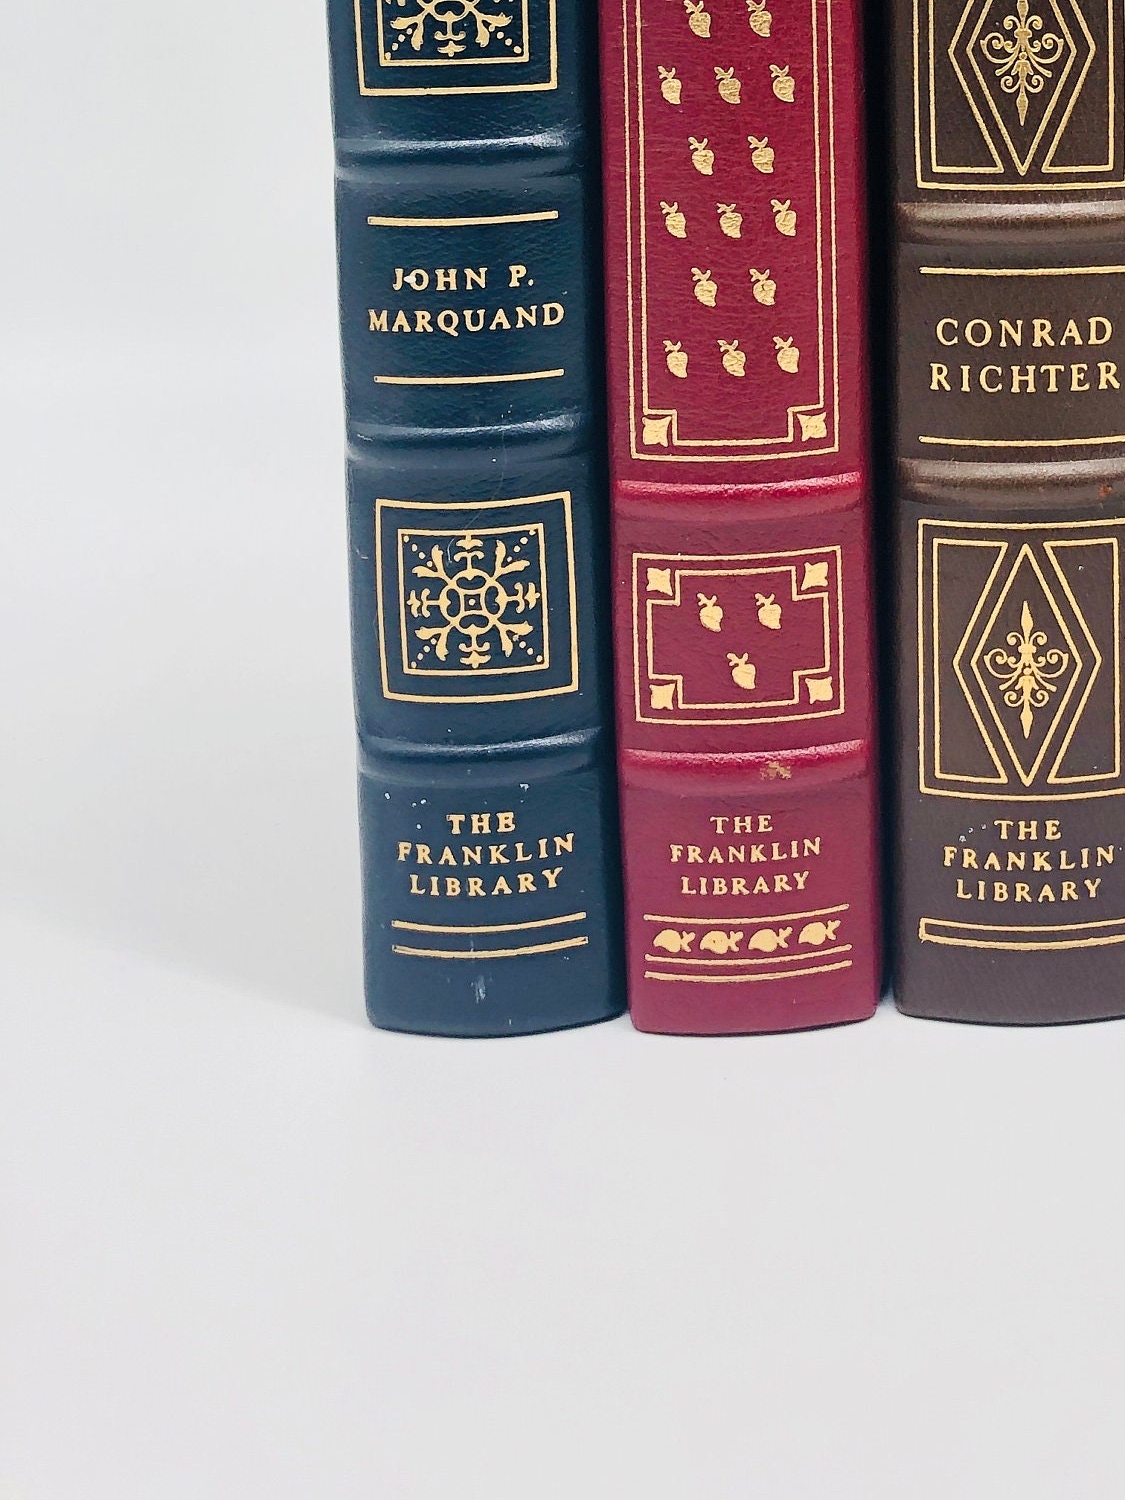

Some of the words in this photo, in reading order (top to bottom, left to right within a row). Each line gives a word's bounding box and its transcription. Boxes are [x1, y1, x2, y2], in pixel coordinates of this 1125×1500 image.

[392, 267, 488, 291] JOHN
[508, 264, 534, 288] P.
[367, 302, 565, 337] MARQUAND
[936, 316, 1113, 348] CONRAD
[929, 361, 1121, 393] RICHTER
[445, 811, 516, 835] THE
[709, 814, 773, 834] THE
[993, 819, 1062, 841] THE
[397, 834, 575, 866] FRANKLIN
[669, 836, 821, 864] FRANKLIN
[943, 844, 1115, 872] FRANKLIN
[409, 866, 564, 897] LIBRARY
[680, 870, 810, 896] LIBRARY
[956, 877, 1102, 903] LIBRARY
